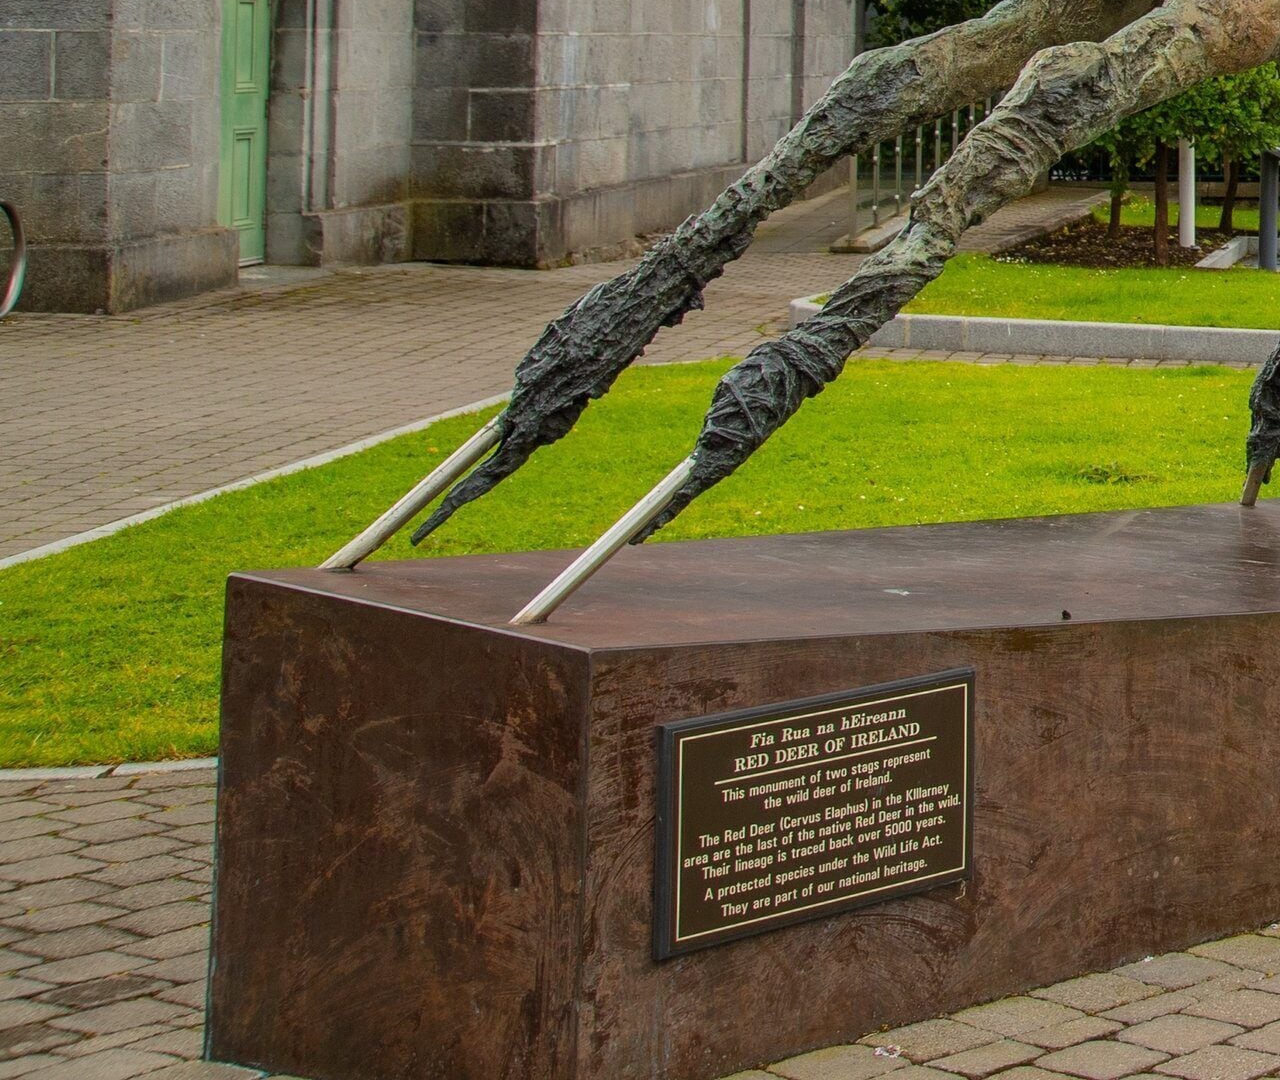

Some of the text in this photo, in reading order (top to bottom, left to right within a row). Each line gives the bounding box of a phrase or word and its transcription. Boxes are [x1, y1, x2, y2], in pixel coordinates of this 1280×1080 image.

[735, 723, 920, 772] RED DEER OF IRELAND
[750, 709, 905, 748] Fia Rua na hEireann
[722, 749, 930, 802] This monument of two stags represent
[764, 771, 892, 809] the wild deer of Ireland.
[684, 794, 961, 867] area are the last of the native Red Deer in the wild.
[699, 835, 719, 847] The
[725, 827, 745, 842] Red
[750, 823, 775, 837] Deer
[780, 813, 820, 830] (Cervus
[825, 799, 868, 820] Elaphus)
[873, 798, 881, 809] in
[886, 794, 902, 806] the
[702, 816, 945, 879] Their lineage is traced back over 5000 years.
[705, 835, 942, 901] A protected species under the Wild Life Act.
[721, 859, 927, 916] They are part of our national heritage.
